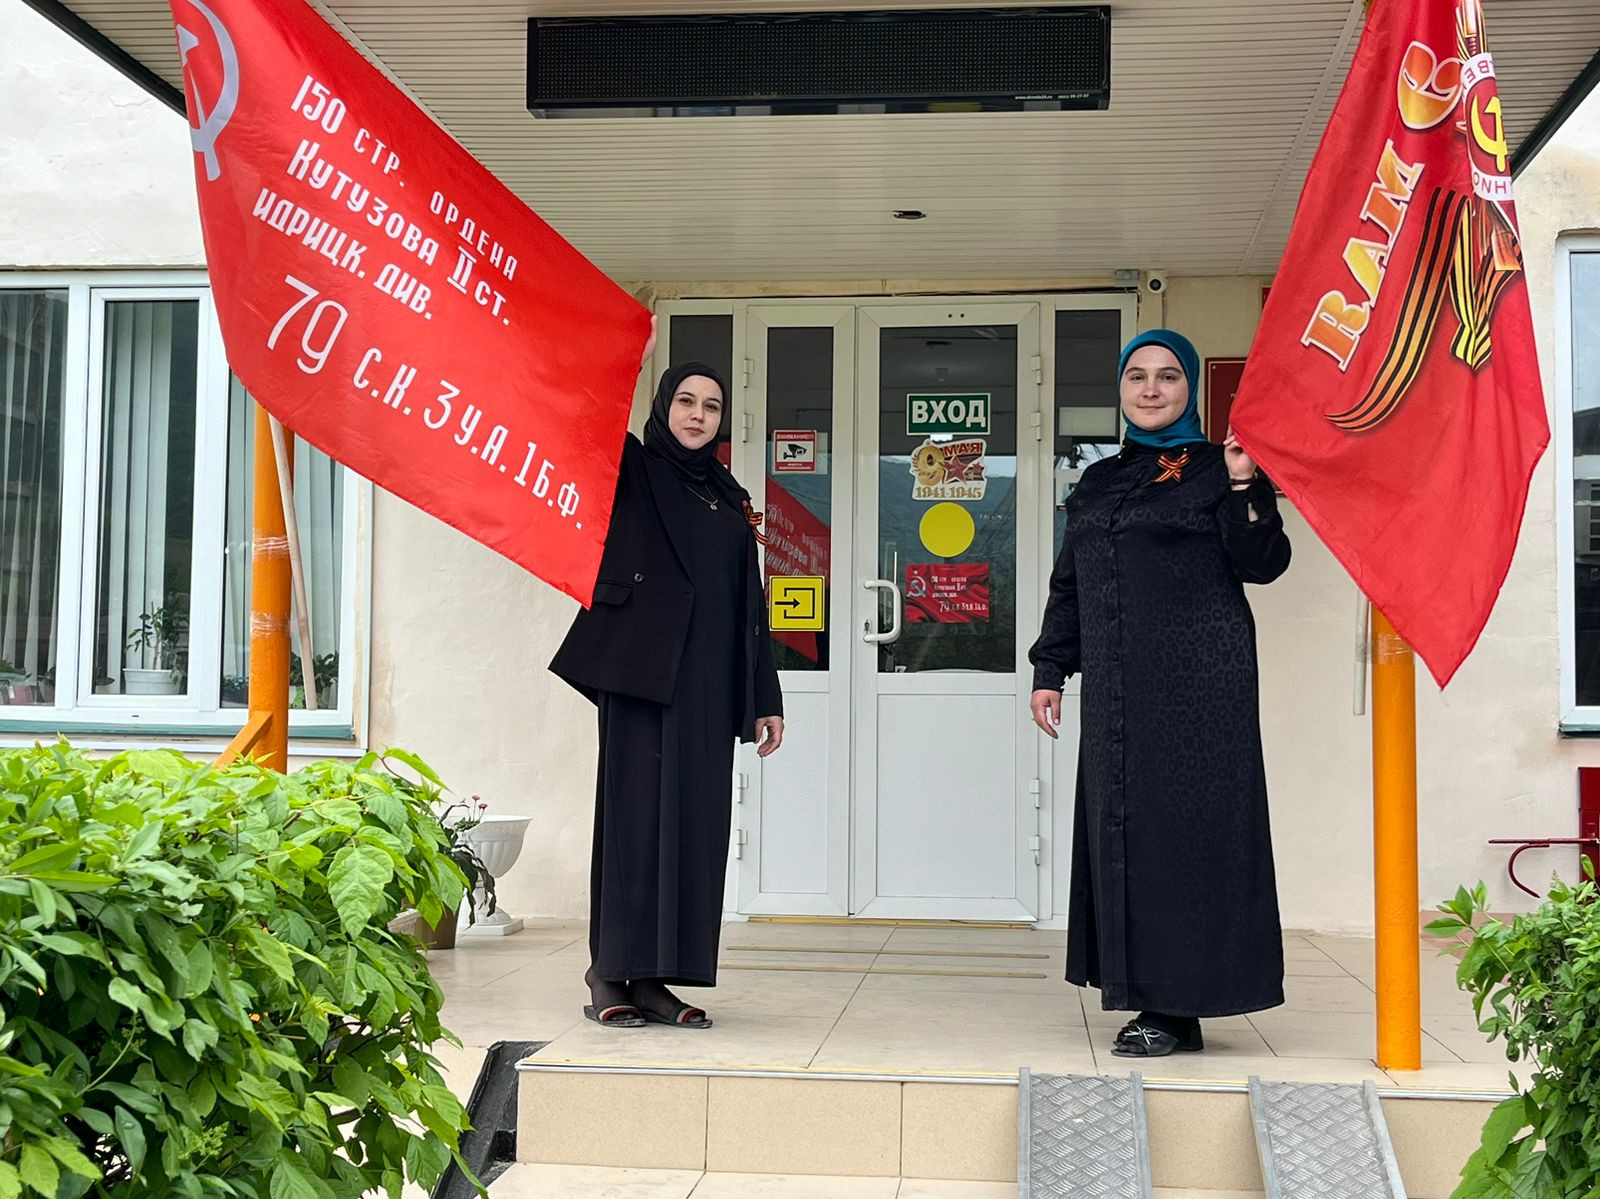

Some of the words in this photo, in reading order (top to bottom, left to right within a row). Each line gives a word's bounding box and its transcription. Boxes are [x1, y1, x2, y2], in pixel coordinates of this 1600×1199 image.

[291, 75, 347, 134] 150
[354, 129, 405, 187] СТР.
[431, 191, 518, 281] ОРДЕНА
[253, 188, 365, 279] ИДРИЦК.
[374, 264, 432, 320] ДИВ.
[267, 274, 349, 374] 79
[912, 400, 986, 428] ВХОД
[916, 445, 945, 486] 9
[943, 442, 982, 457] МАЯ
